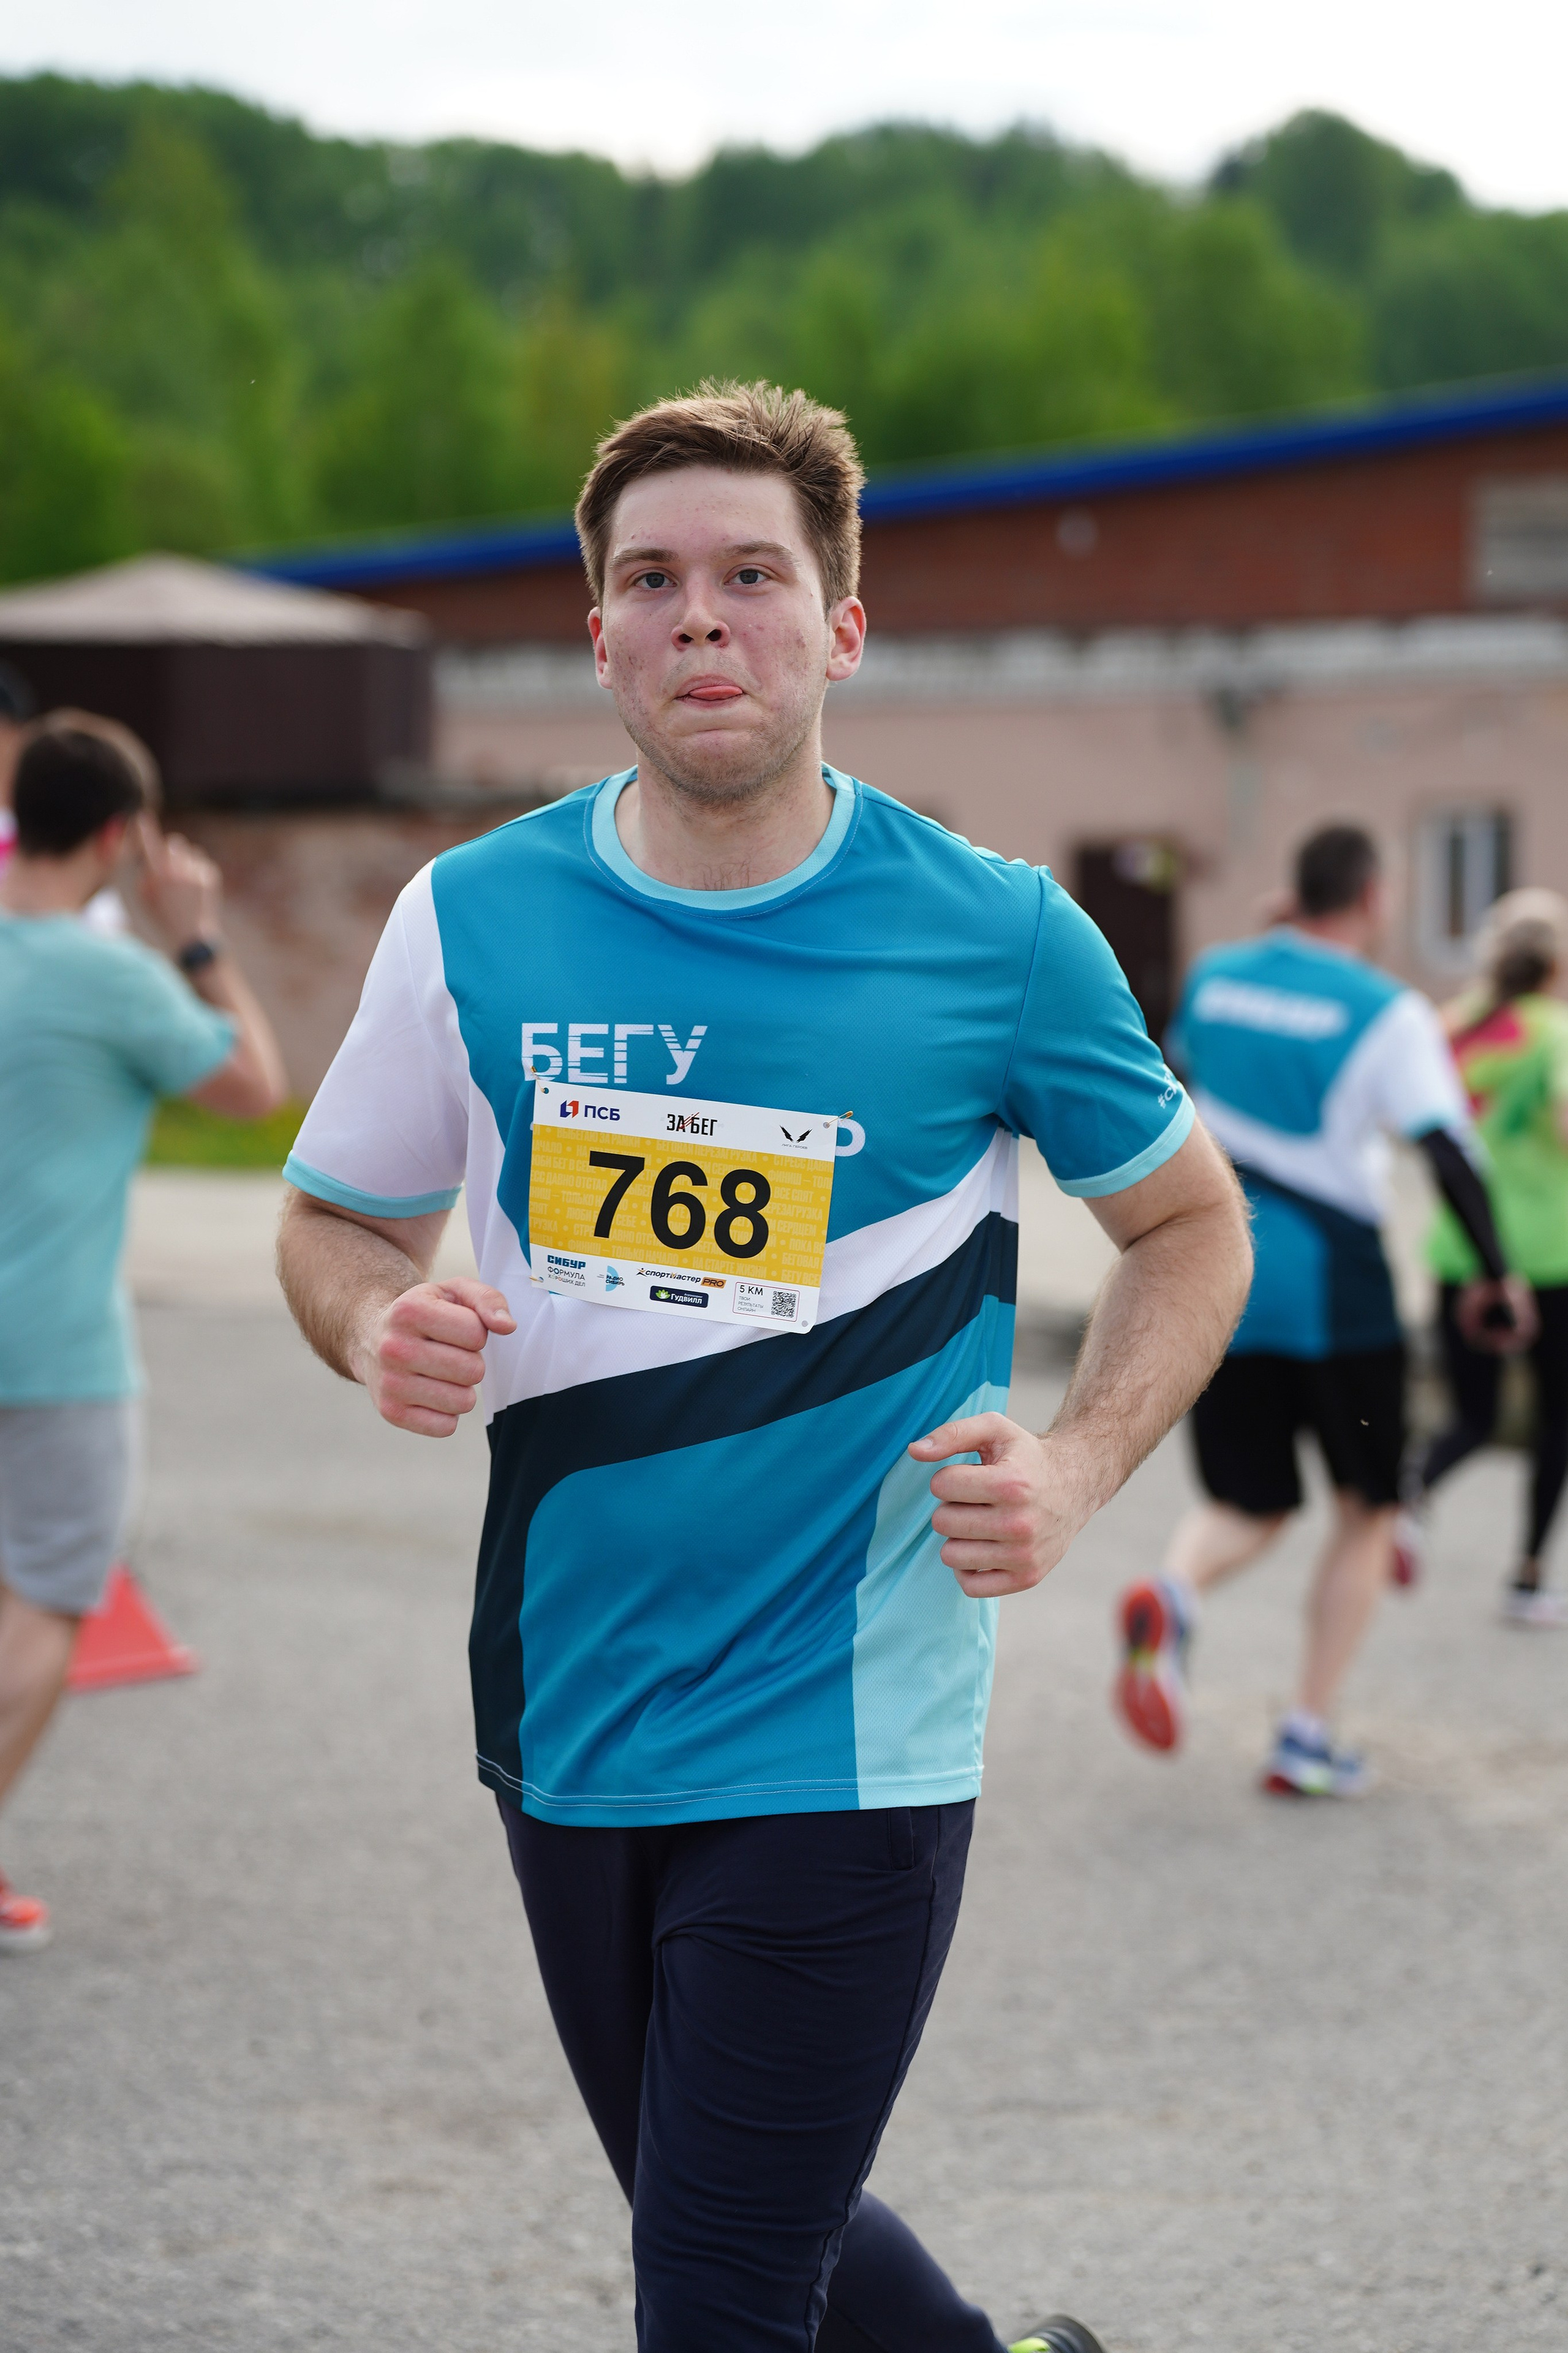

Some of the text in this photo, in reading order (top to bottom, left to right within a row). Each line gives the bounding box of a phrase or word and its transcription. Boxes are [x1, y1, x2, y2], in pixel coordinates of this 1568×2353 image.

[522, 1022, 707, 1085] БЕГУ
[584, 1105, 620, 1121] ПСБ
[590, 1151, 770, 1258] 768
[548, 1255, 586, 1269] СИБУР
[548, 1266, 586, 1280] ФОРМУЛА
[703, 1278, 725, 1287] PRO
[671, 1293, 703, 1304] Гудвилл
